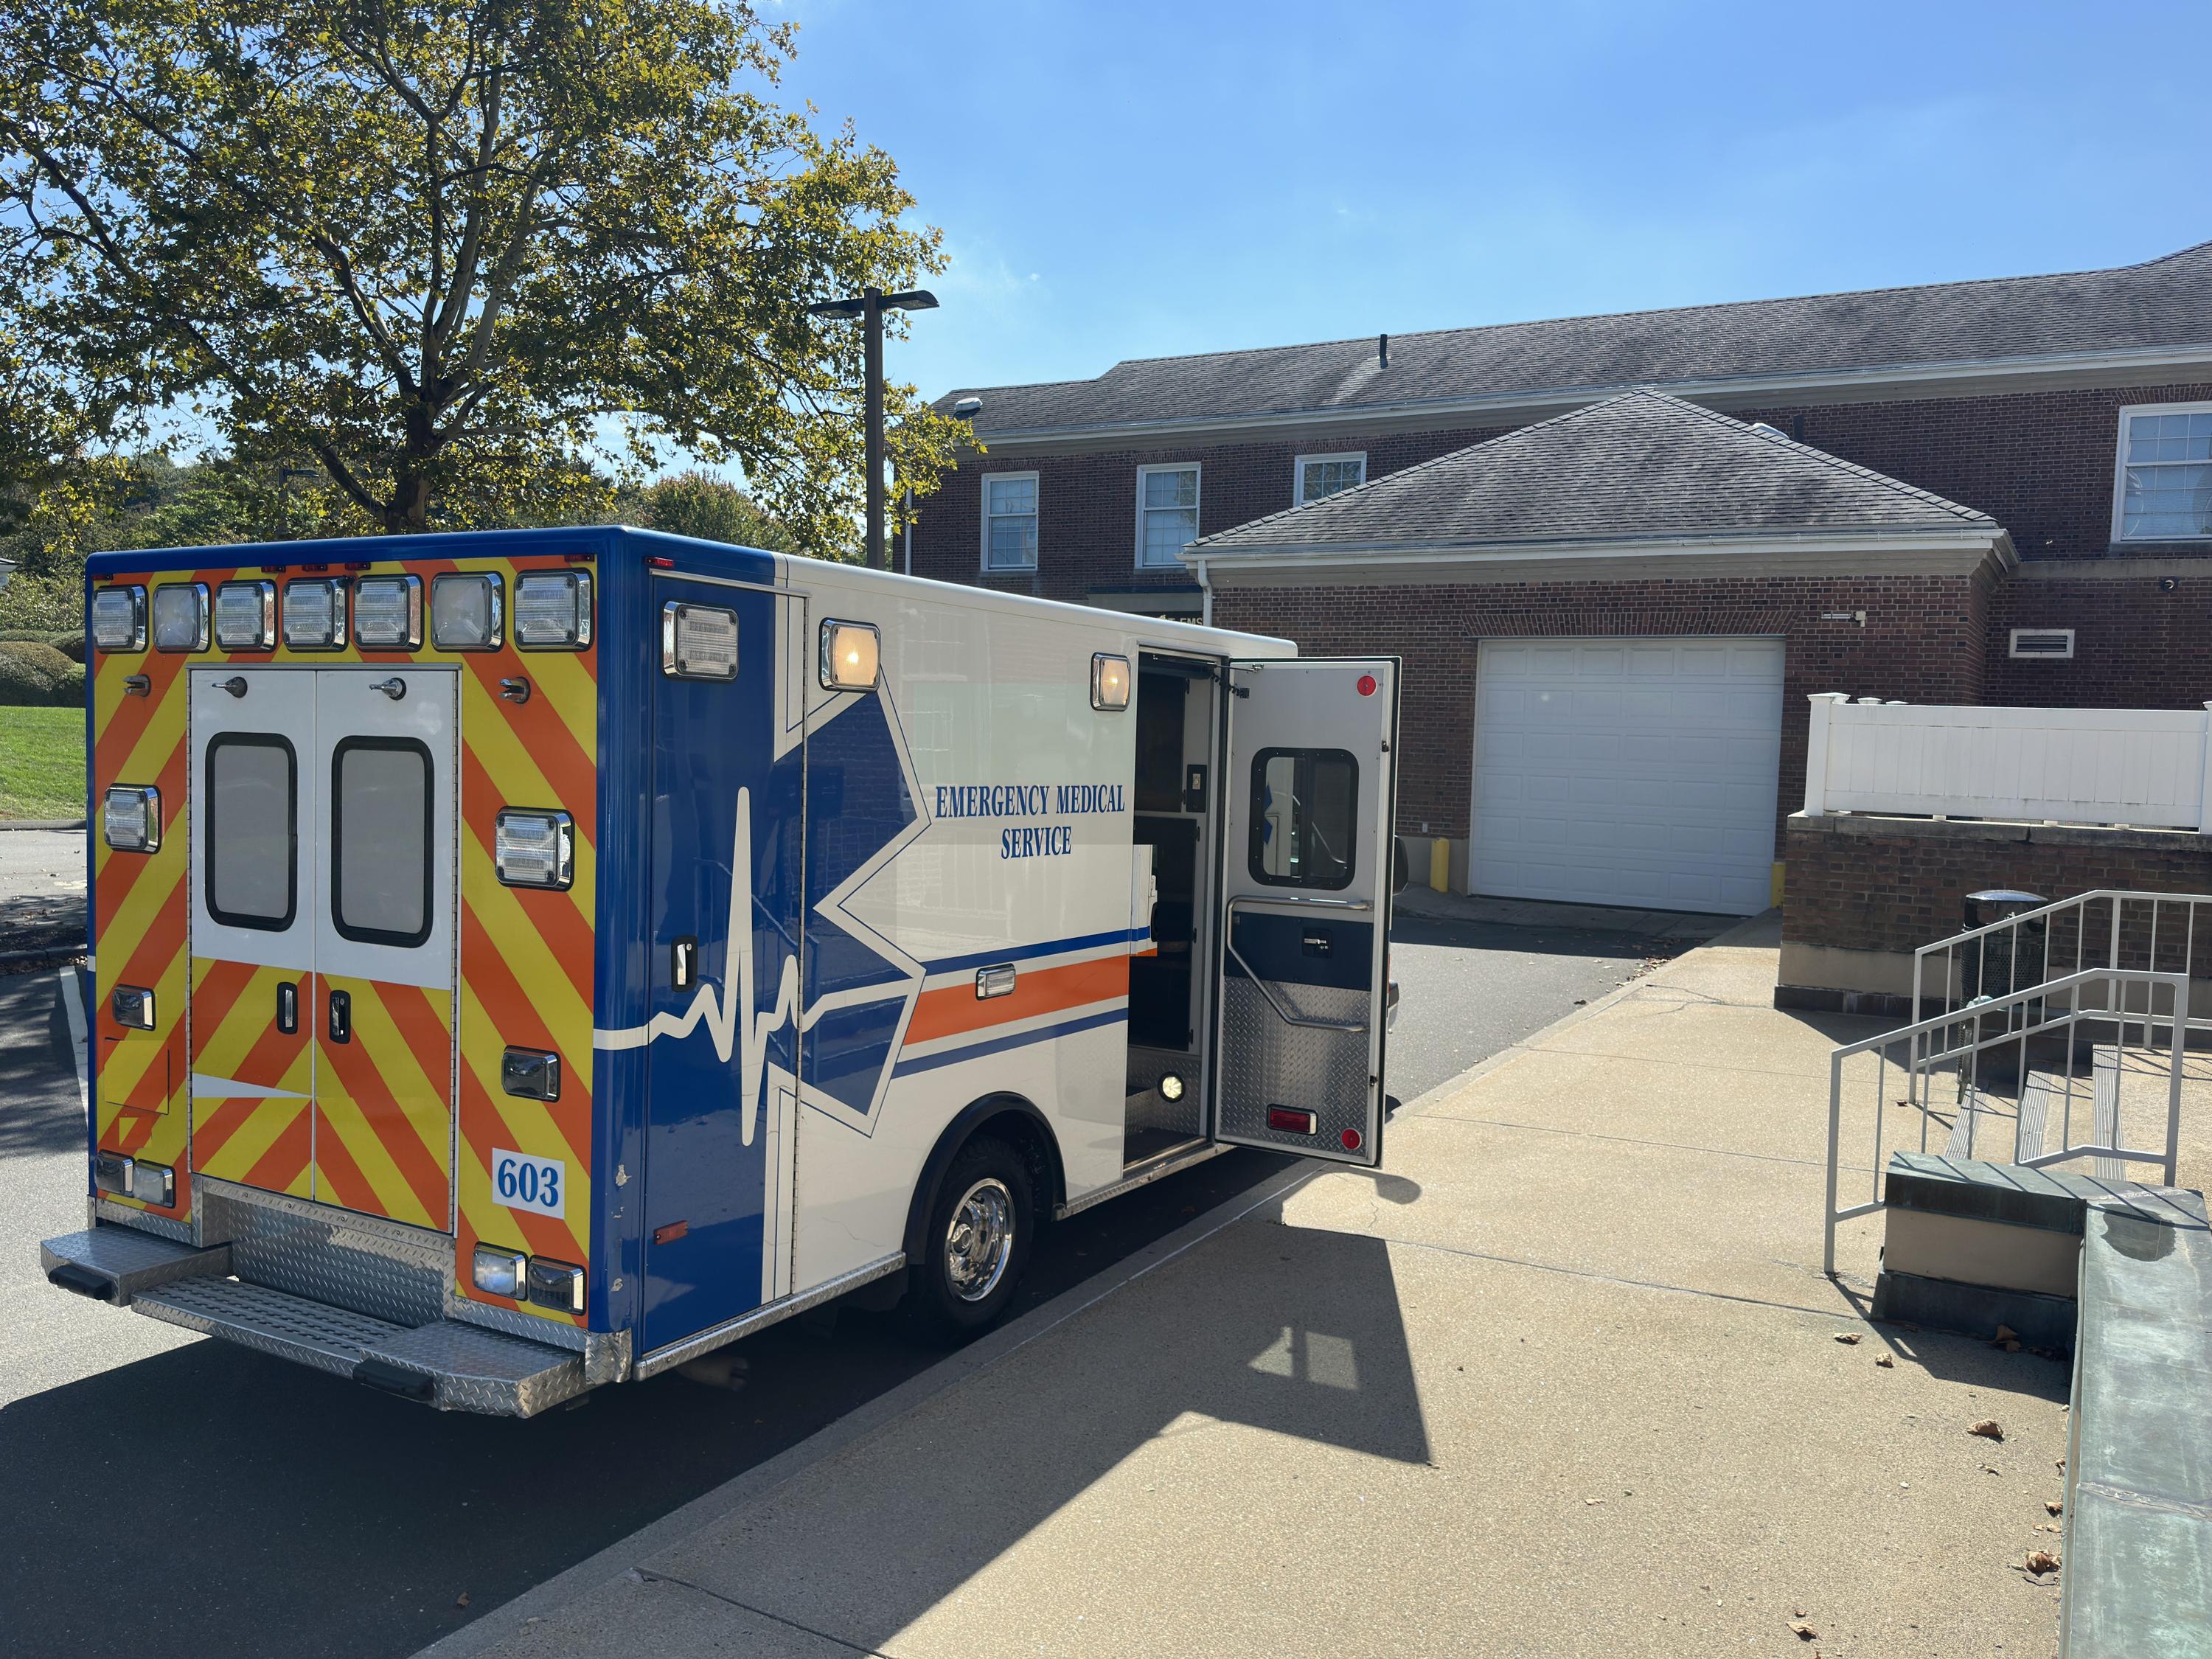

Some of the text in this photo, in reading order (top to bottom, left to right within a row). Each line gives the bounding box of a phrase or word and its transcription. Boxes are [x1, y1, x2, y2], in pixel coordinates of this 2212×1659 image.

[935, 785, 1125, 818] EMERGENCY MEDICAL
[1001, 826, 1072, 860] SERVICE
[498, 1158, 559, 1208] 603
